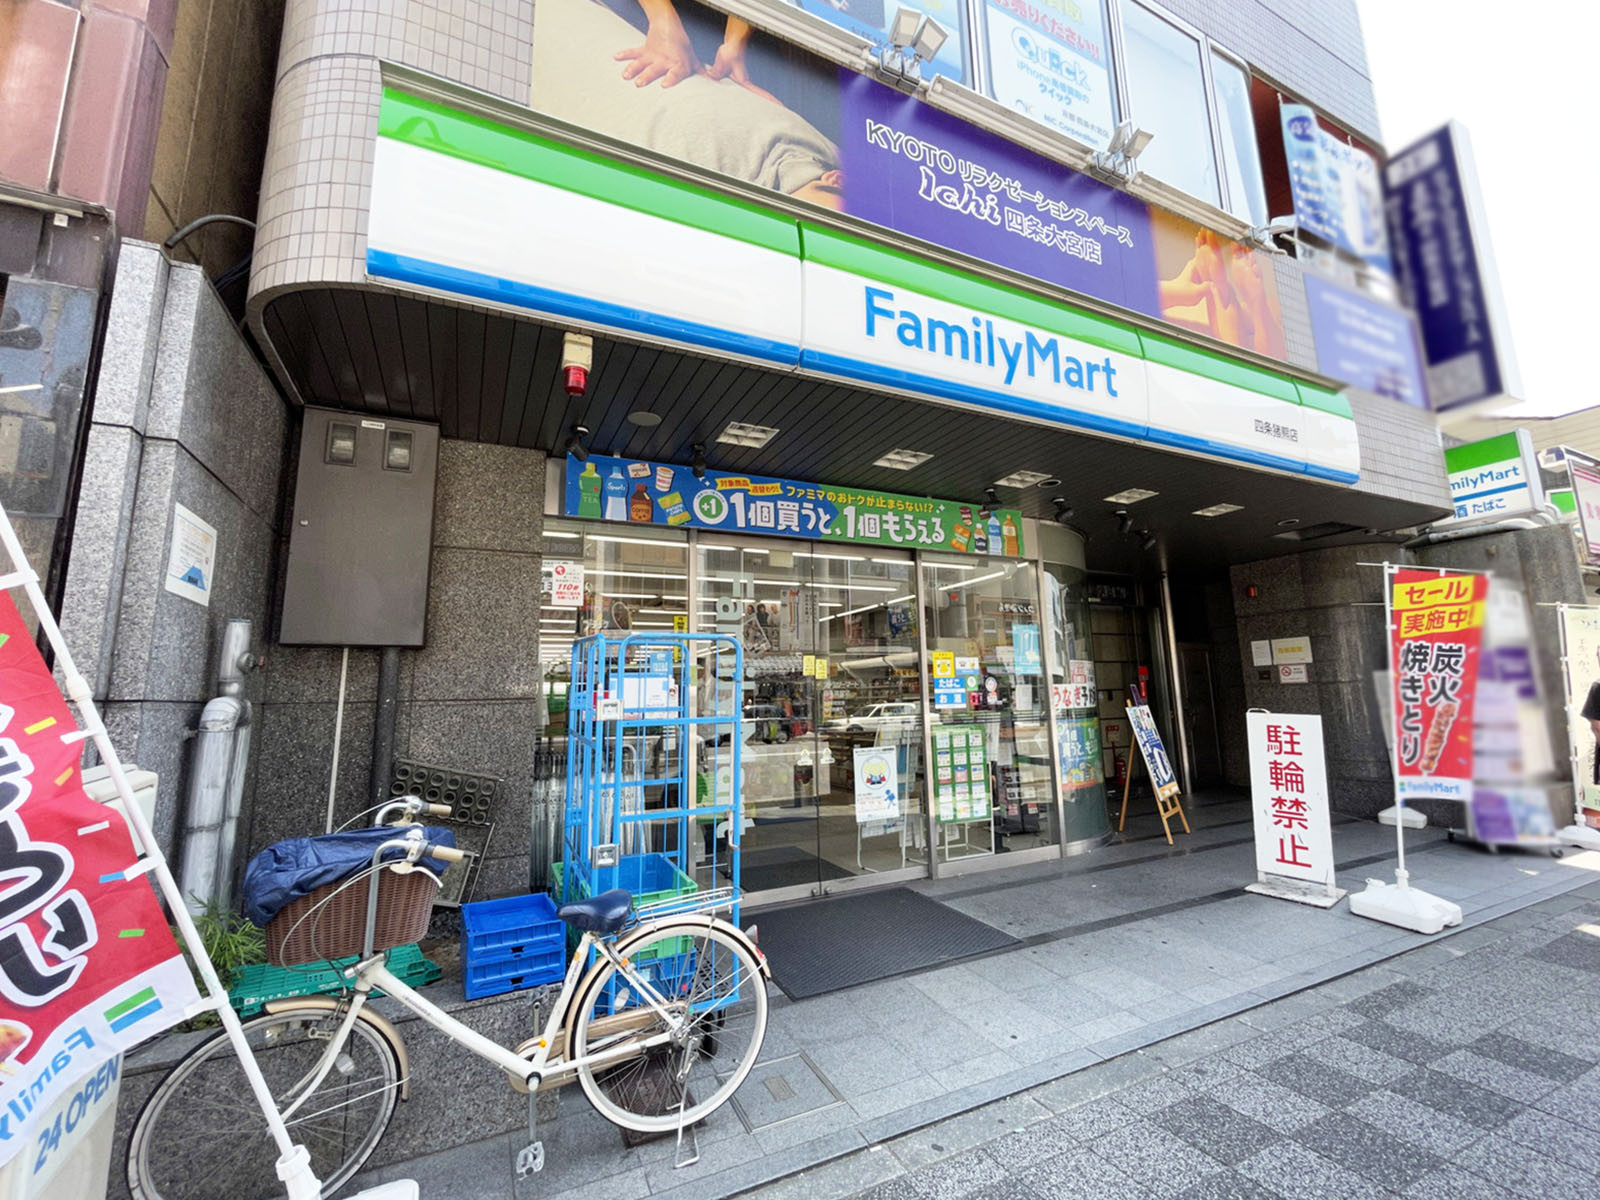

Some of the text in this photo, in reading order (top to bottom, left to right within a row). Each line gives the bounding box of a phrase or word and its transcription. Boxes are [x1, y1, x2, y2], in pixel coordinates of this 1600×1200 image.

[866, 119, 1134, 248] KYOTO リラクゼーションスペース
[919, 166, 1102, 264] Ichi 四条大宮店
[865, 286, 1118, 398] FamilyMart
[786, 485, 934, 513] ファミマのおトクが止まらない!?
[1472, 498, 1506, 513] たばこ
[1406, 580, 1468, 605] セール
[1401, 643, 1431, 764] 焼きとり
[1428, 644, 1464, 704] 炭火
[1266, 724, 1312, 868] 駐輪禁止
[66, 1053, 120, 1134] OPEN
